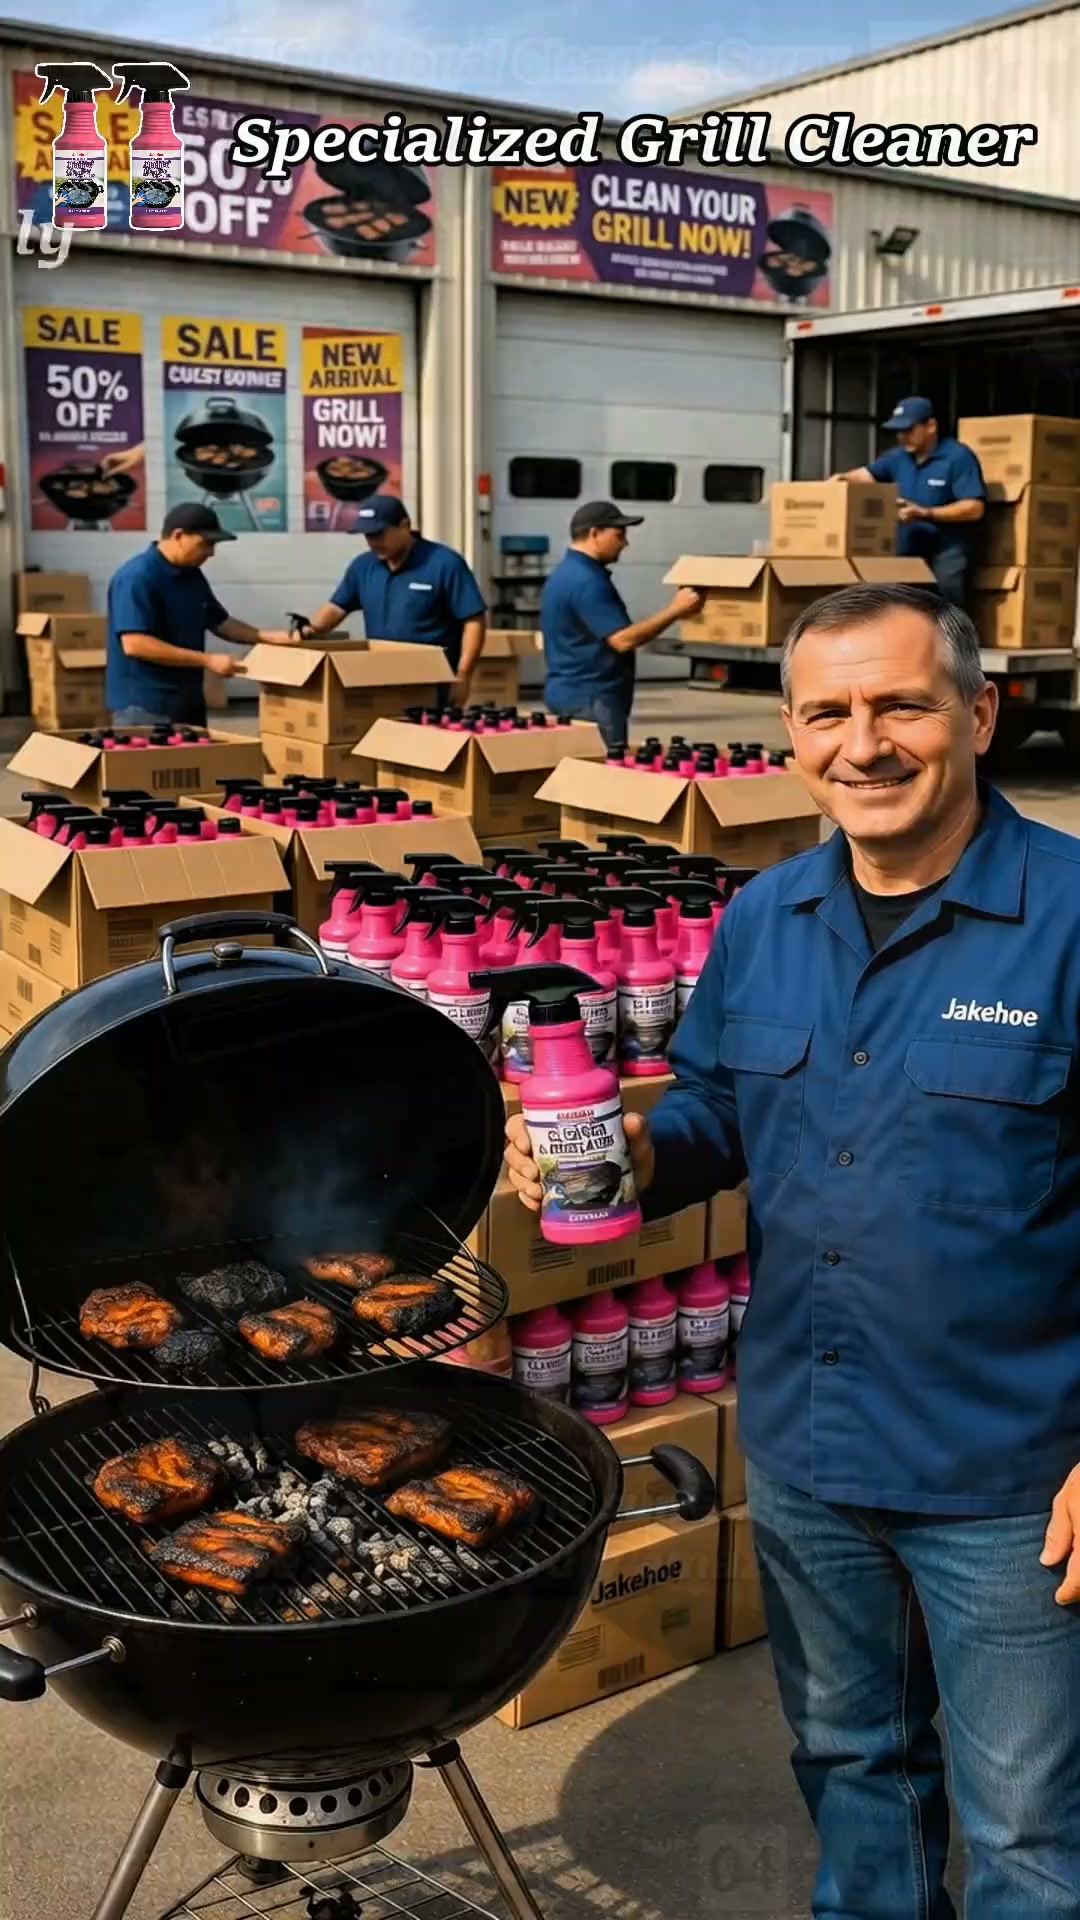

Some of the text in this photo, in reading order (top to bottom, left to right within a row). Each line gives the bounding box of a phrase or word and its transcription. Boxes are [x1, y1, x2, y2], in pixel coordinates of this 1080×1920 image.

[31, 110, 130, 147] SE
[184, 190, 274, 237] OFF
[503, 187, 568, 215] NEW
[591, 173, 757, 226] CLEAN YOUR
[592, 209, 753, 259] GRILL NOW!
[37, 313, 121, 345] SALE
[177, 323, 277, 362] SALE
[321, 342, 382, 368] NEW
[46, 363, 129, 402] 50%
[309, 367, 398, 389] ARRIVAL
[55, 400, 113, 428] OFF
[312, 397, 384, 423] GRILL
[318, 422, 387, 448] NOW!
[941, 997, 1039, 1027] Jakehoe
[590, 1559, 683, 1606] Jakehoe
